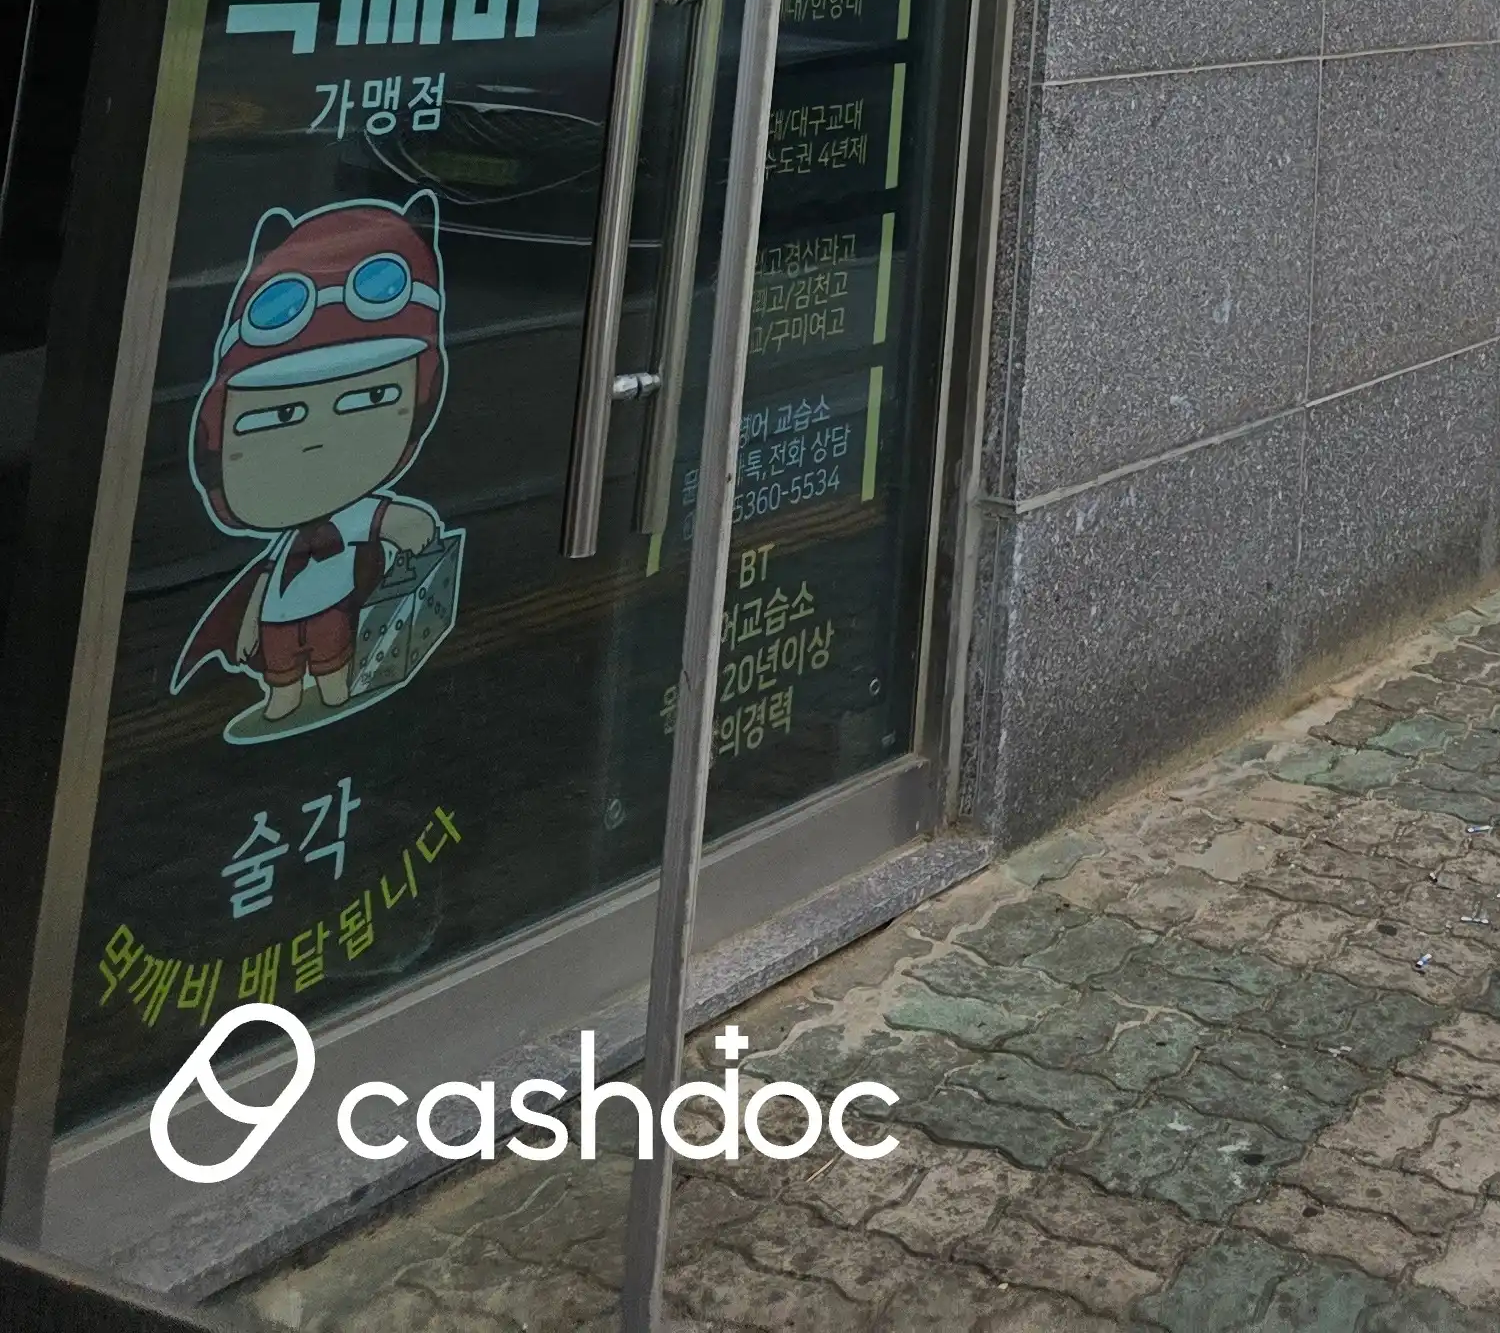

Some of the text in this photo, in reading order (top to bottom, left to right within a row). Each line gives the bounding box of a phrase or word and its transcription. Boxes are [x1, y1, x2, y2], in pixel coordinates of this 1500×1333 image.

[308, 72, 447, 139] 가맹점
[817, 134, 868, 169] 4년제
[774, 394, 831, 434] 교습소
[811, 423, 852, 464] 상담
[739, 543, 776, 589] BT
[719, 619, 835, 702] 20년이상
[221, 776, 362, 919] 술각
[237, 805, 462, 1004] 배달됩니다
